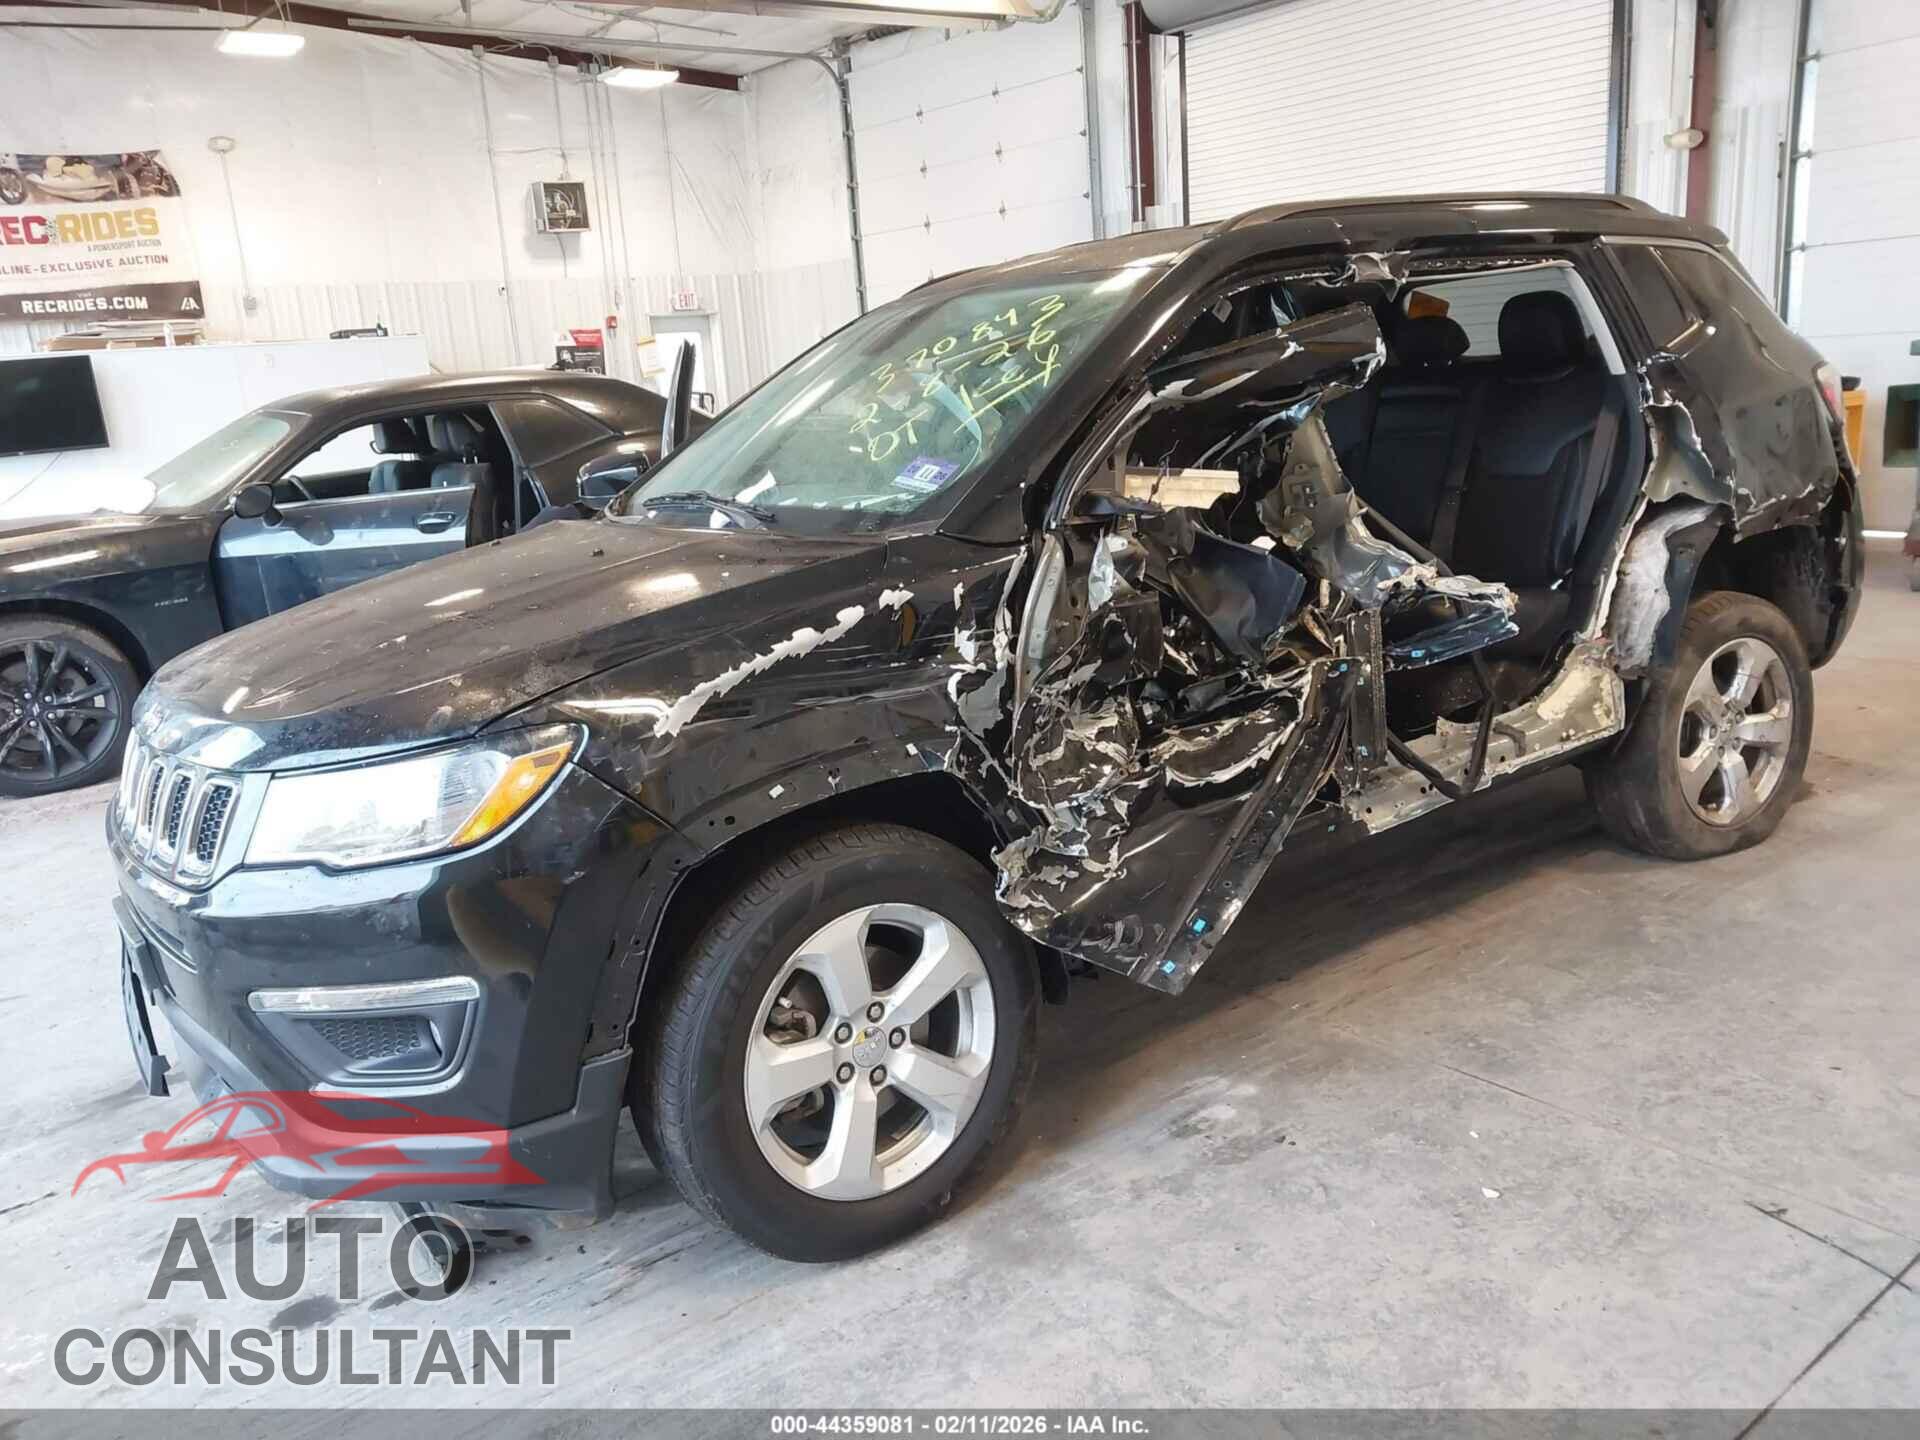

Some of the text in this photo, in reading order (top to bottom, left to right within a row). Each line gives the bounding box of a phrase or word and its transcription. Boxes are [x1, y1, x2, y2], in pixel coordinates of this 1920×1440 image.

[0, 207, 160, 246] EC RIDES
[0, 254, 168, 275] LINE-EXCLUSIVE AUCTION
[21, 296, 149, 314] RECRIDES.COM
[679, 293, 695, 307] EXIT
